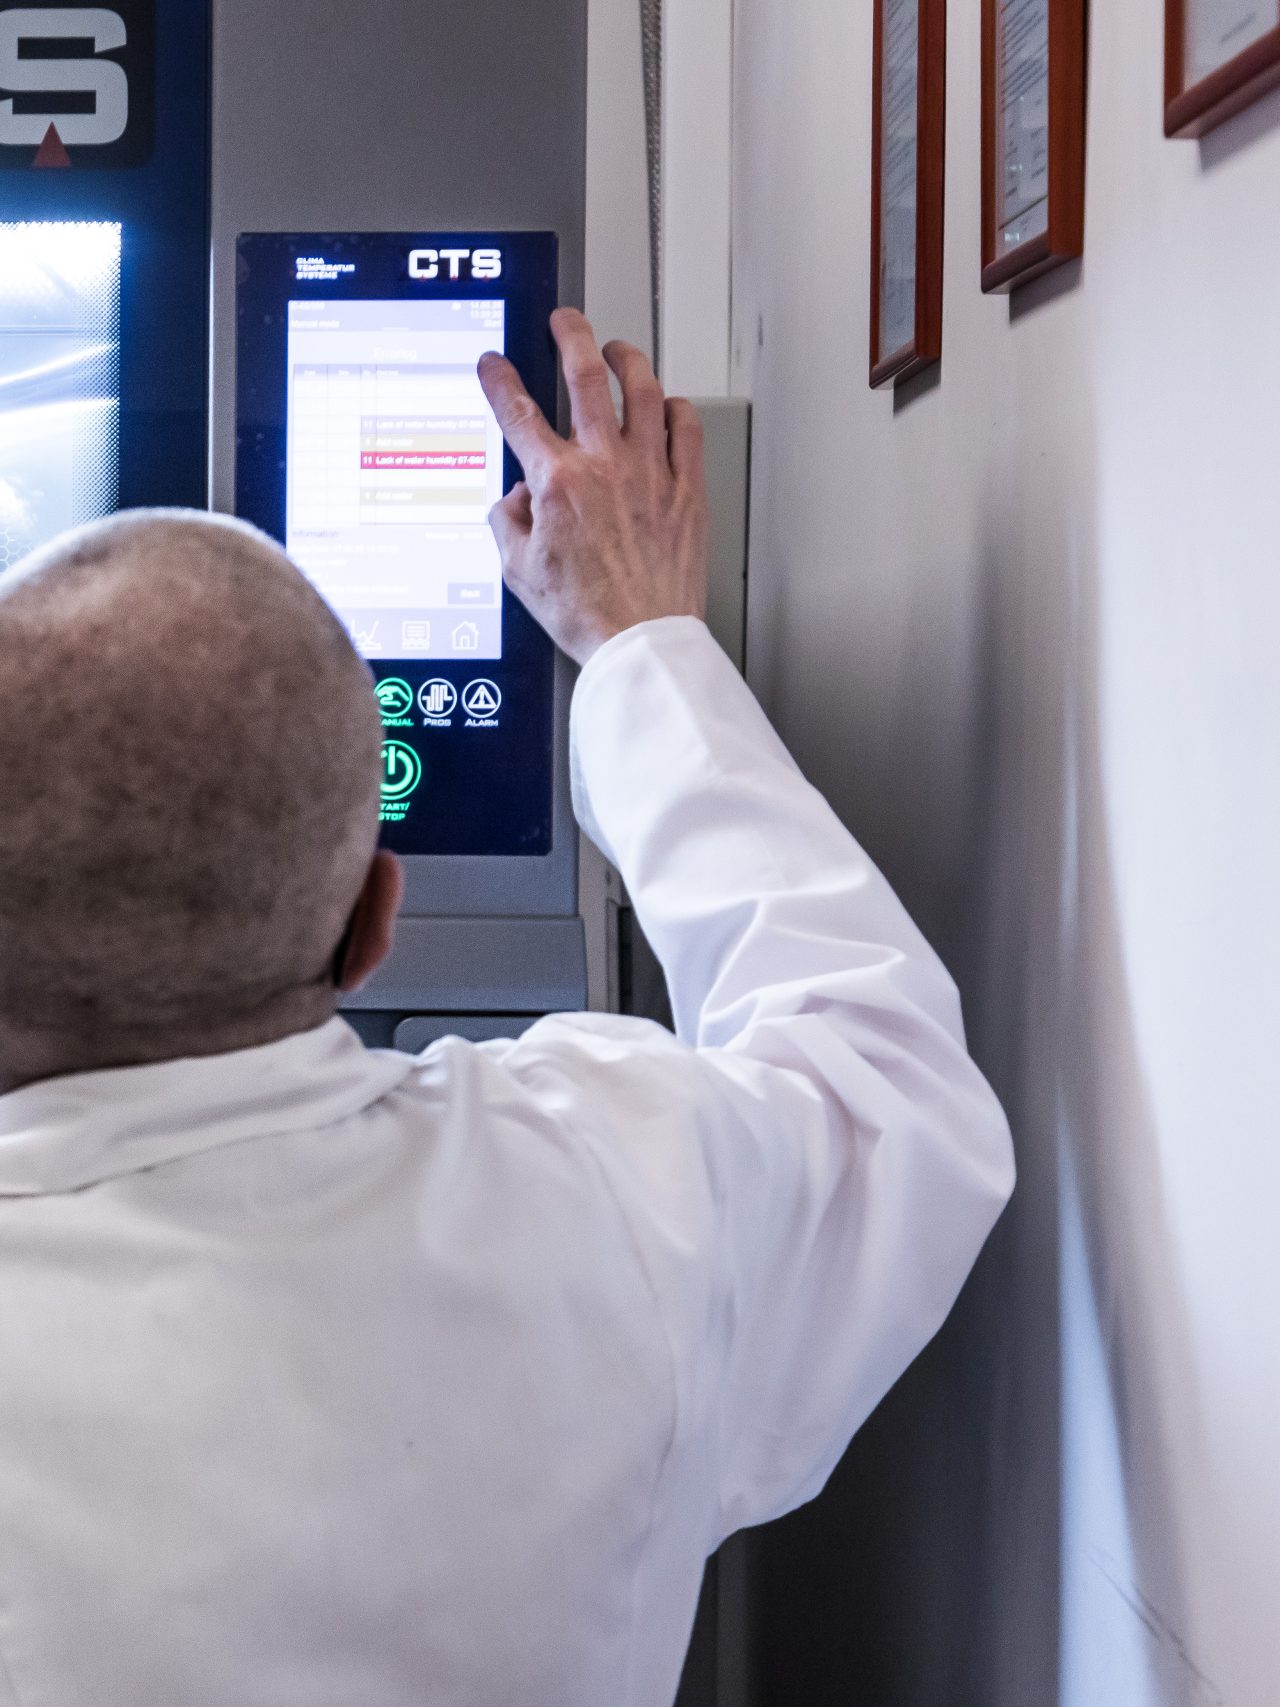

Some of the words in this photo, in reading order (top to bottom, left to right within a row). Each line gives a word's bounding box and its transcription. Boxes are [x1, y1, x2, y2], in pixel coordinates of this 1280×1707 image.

[408, 249, 502, 279] CTS
[395, 456, 403, 465] of
[381, 718, 414, 727] ANUAL
[380, 802, 410, 811] TART/
